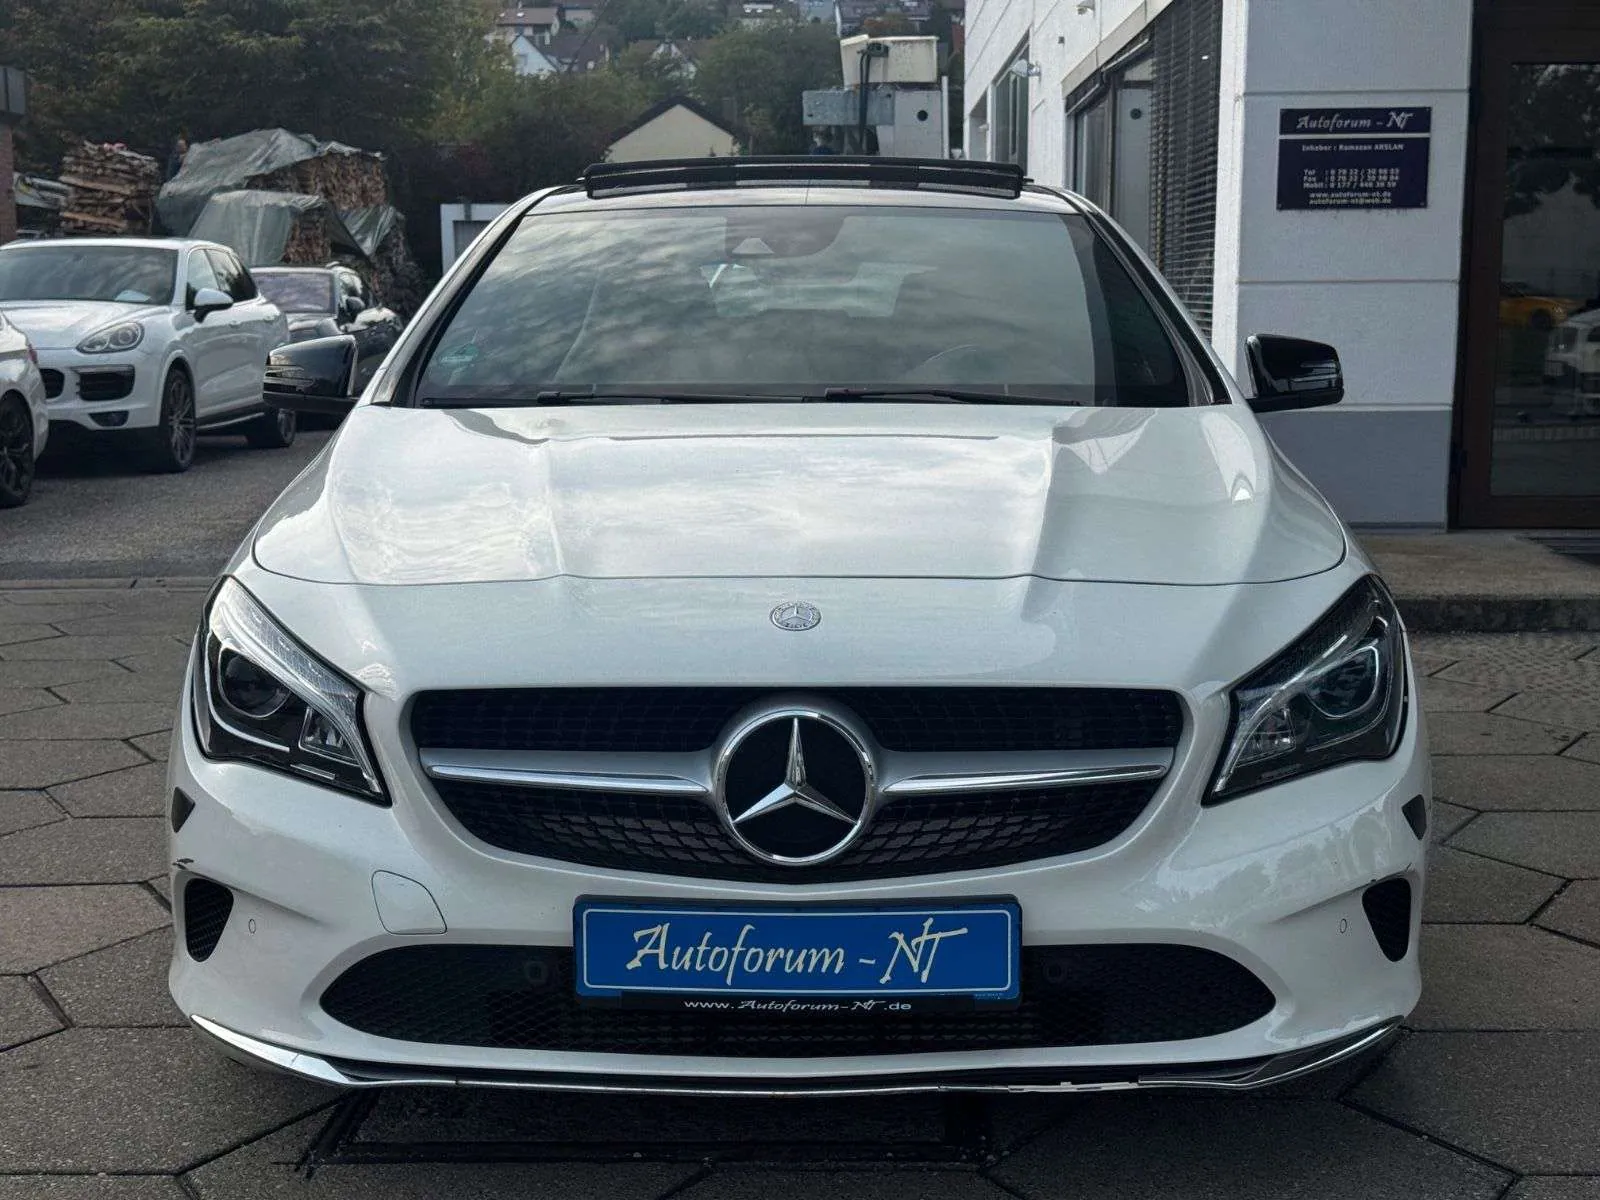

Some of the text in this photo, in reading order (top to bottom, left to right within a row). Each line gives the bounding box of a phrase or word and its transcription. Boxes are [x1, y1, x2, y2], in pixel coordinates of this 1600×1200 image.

[1296, 113, 1371, 132] Autoforum
[1386, 111, 1414, 129] NT
[1374, 143, 1404, 151] ARSLAN
[626, 922, 846, 986] Autoforum
[879, 917, 969, 985] NT
